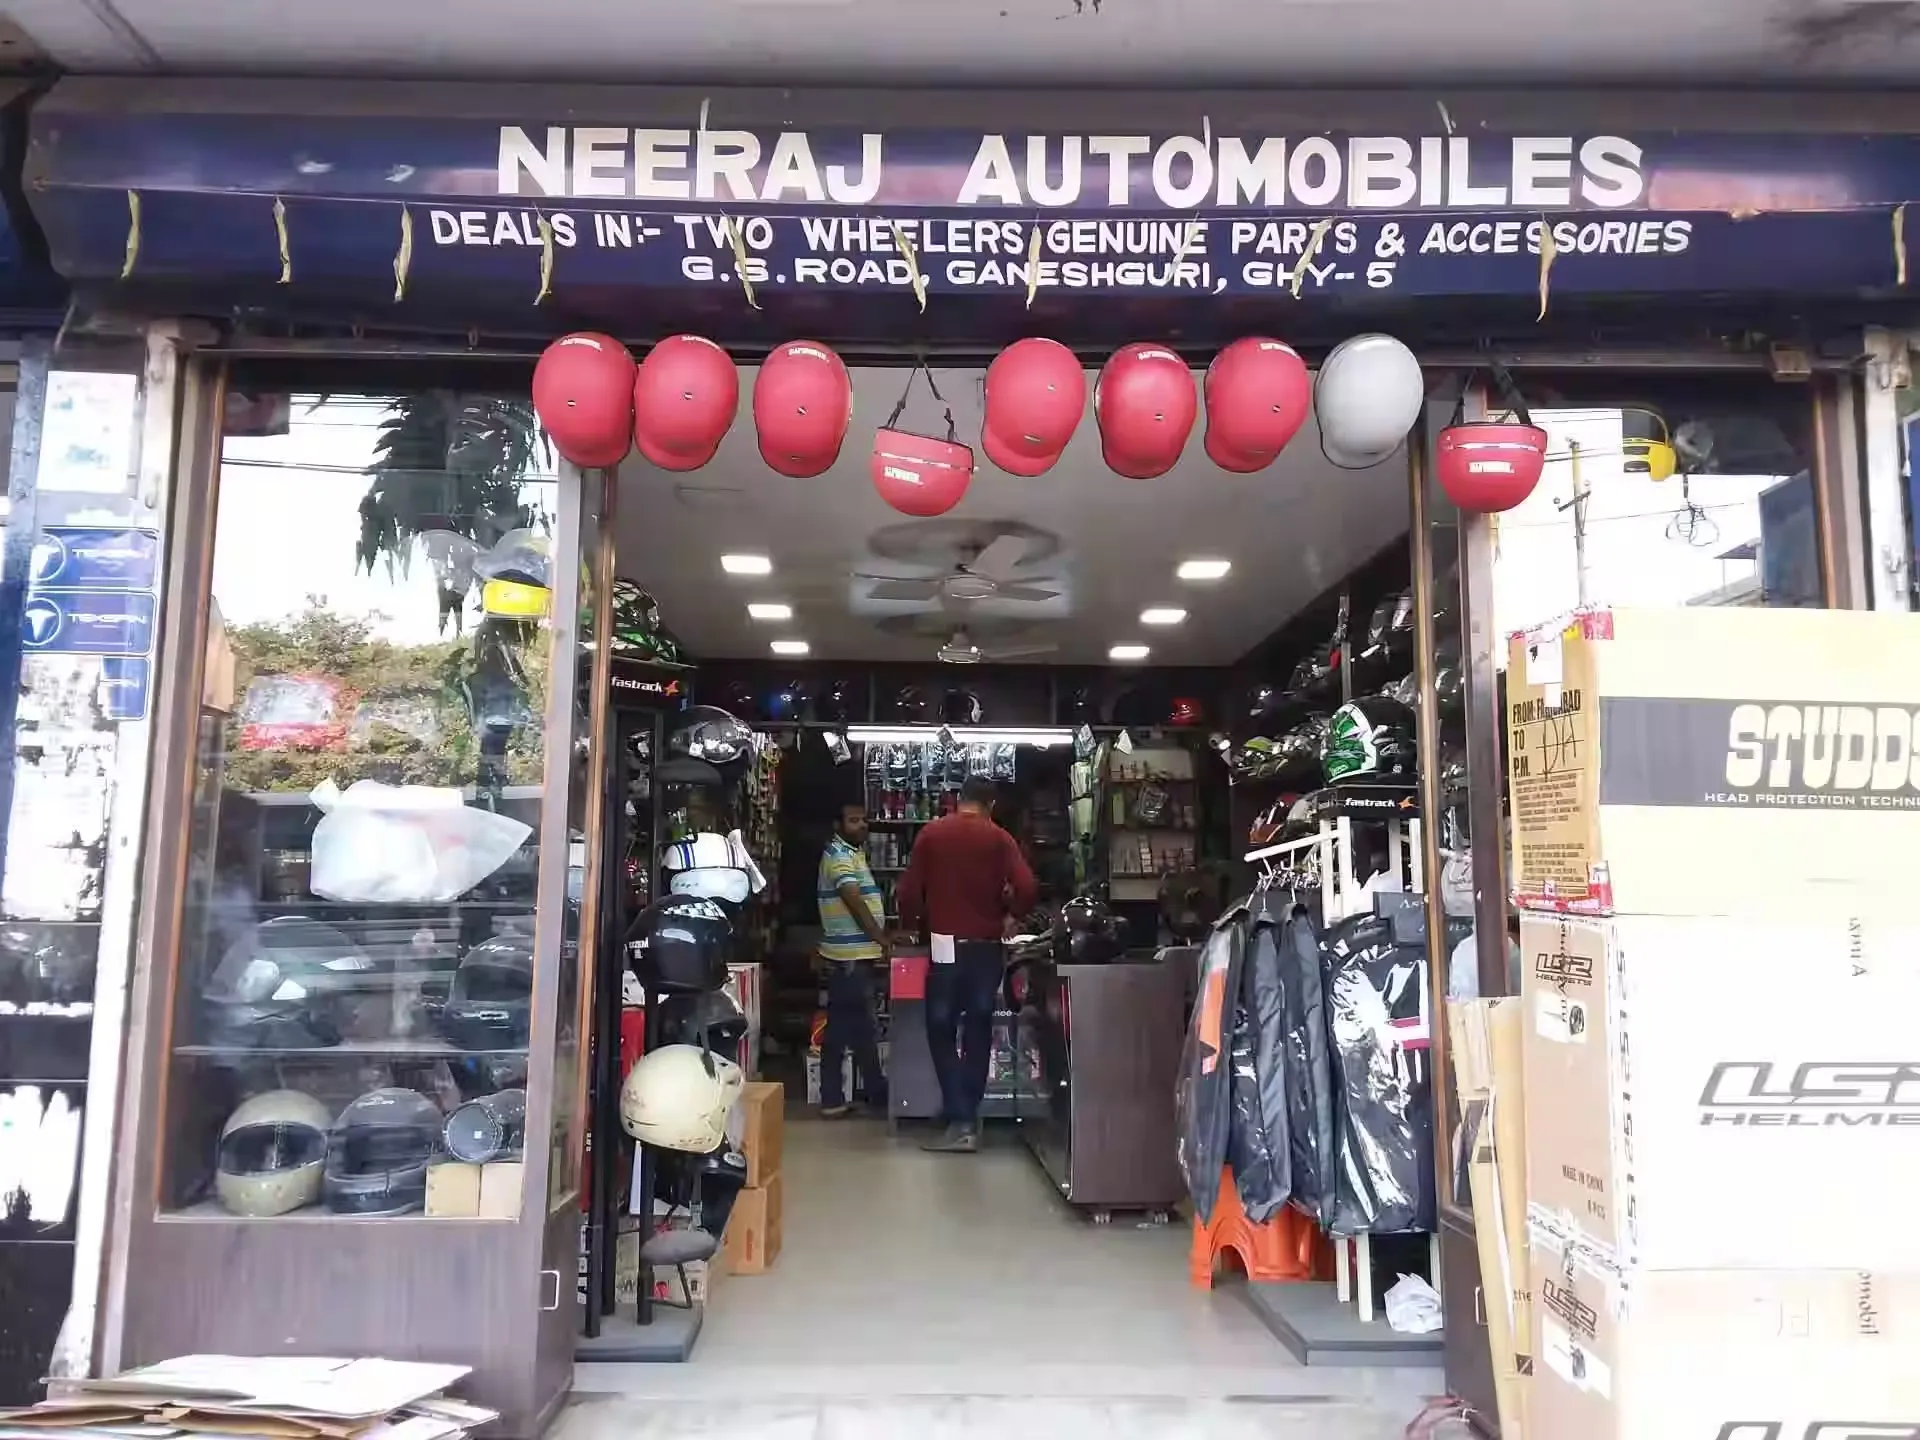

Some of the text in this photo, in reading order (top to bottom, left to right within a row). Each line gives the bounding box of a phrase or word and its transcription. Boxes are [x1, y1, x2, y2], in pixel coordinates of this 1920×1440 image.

[498, 126, 1644, 209] NEERAJ AUTOMOBILES
[430, 210, 577, 248] DEALS
[673, 215, 773, 250] TWO
[801, 217, 1023, 254] WHEELERS
[1046, 220, 1209, 255] GENUINE
[1231, 221, 1358, 255] PARTS
[1375, 221, 1406, 257] &
[611, 676, 663, 693] fastrack
[1513, 729, 1525, 751] TO
[1725, 703, 1920, 791] STUDD
[1345, 797, 1396, 808] fastrack
[1705, 792, 1749, 804] HEAD
[1755, 793, 1856, 806] PROTECTION
